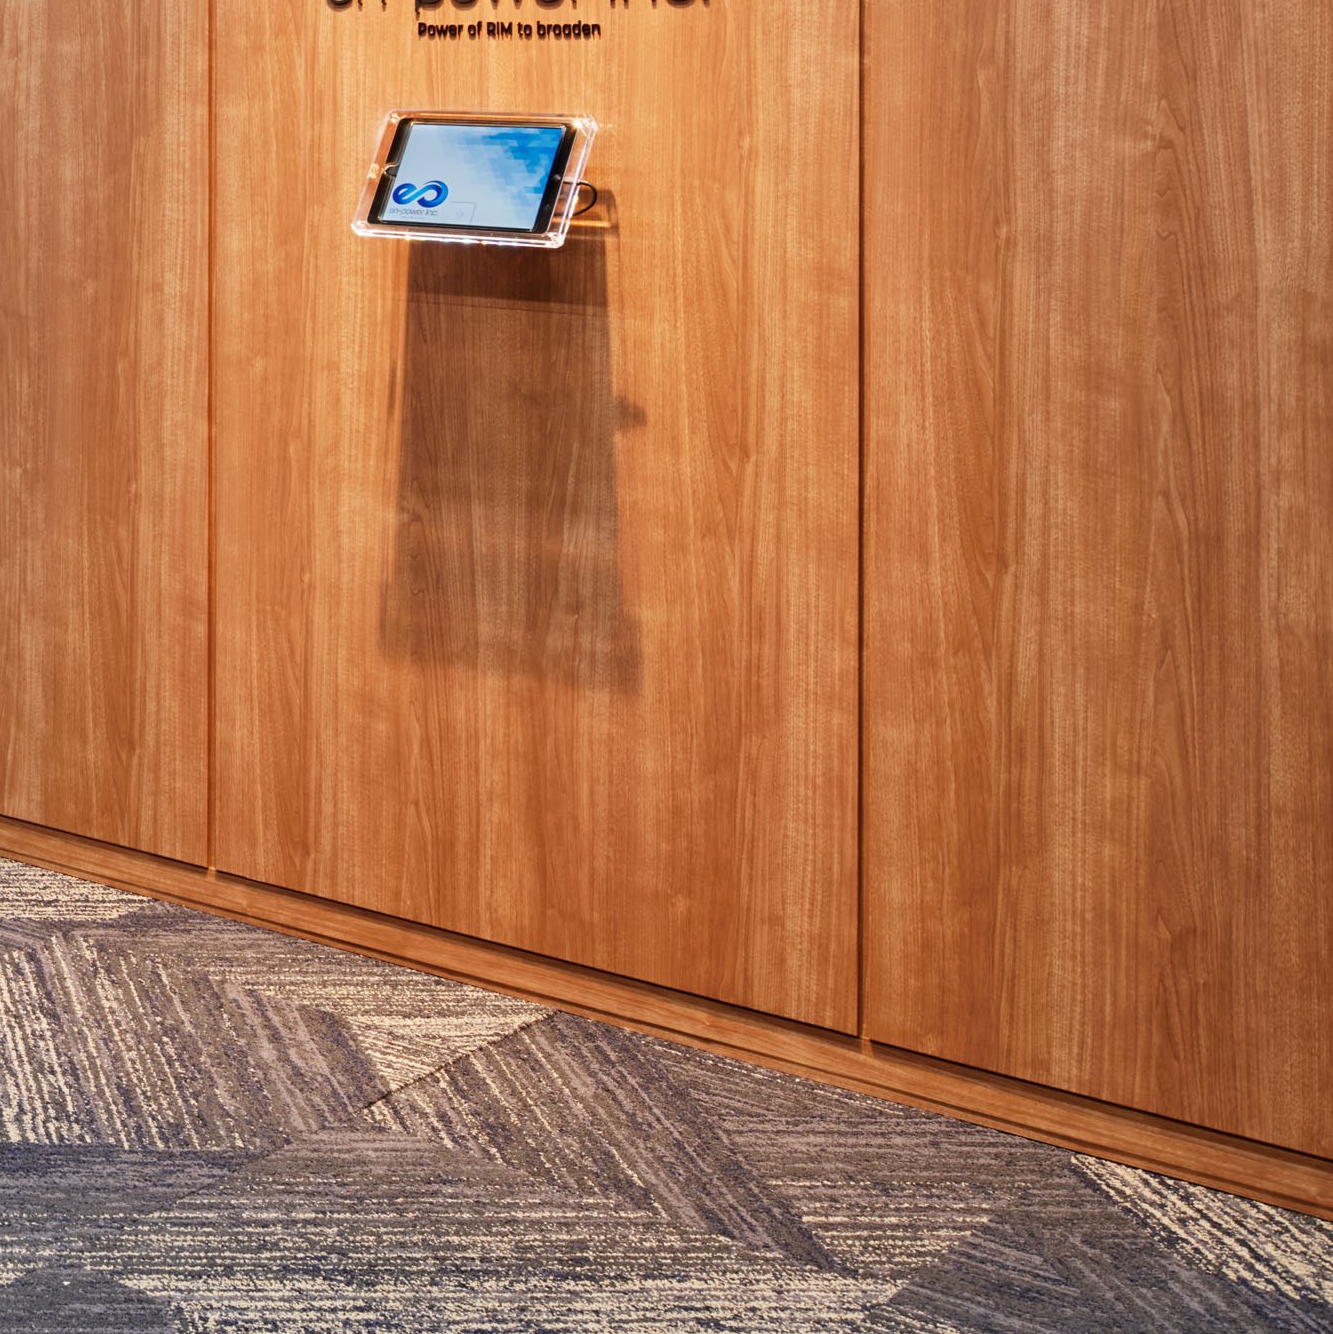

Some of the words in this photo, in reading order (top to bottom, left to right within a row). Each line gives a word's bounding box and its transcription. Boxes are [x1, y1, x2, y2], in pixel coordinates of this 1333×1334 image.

[418, 21, 463, 37] Power
[468, 21, 482, 37] of
[517, 21, 533, 37] to
[536, 20, 602, 37] broaden
